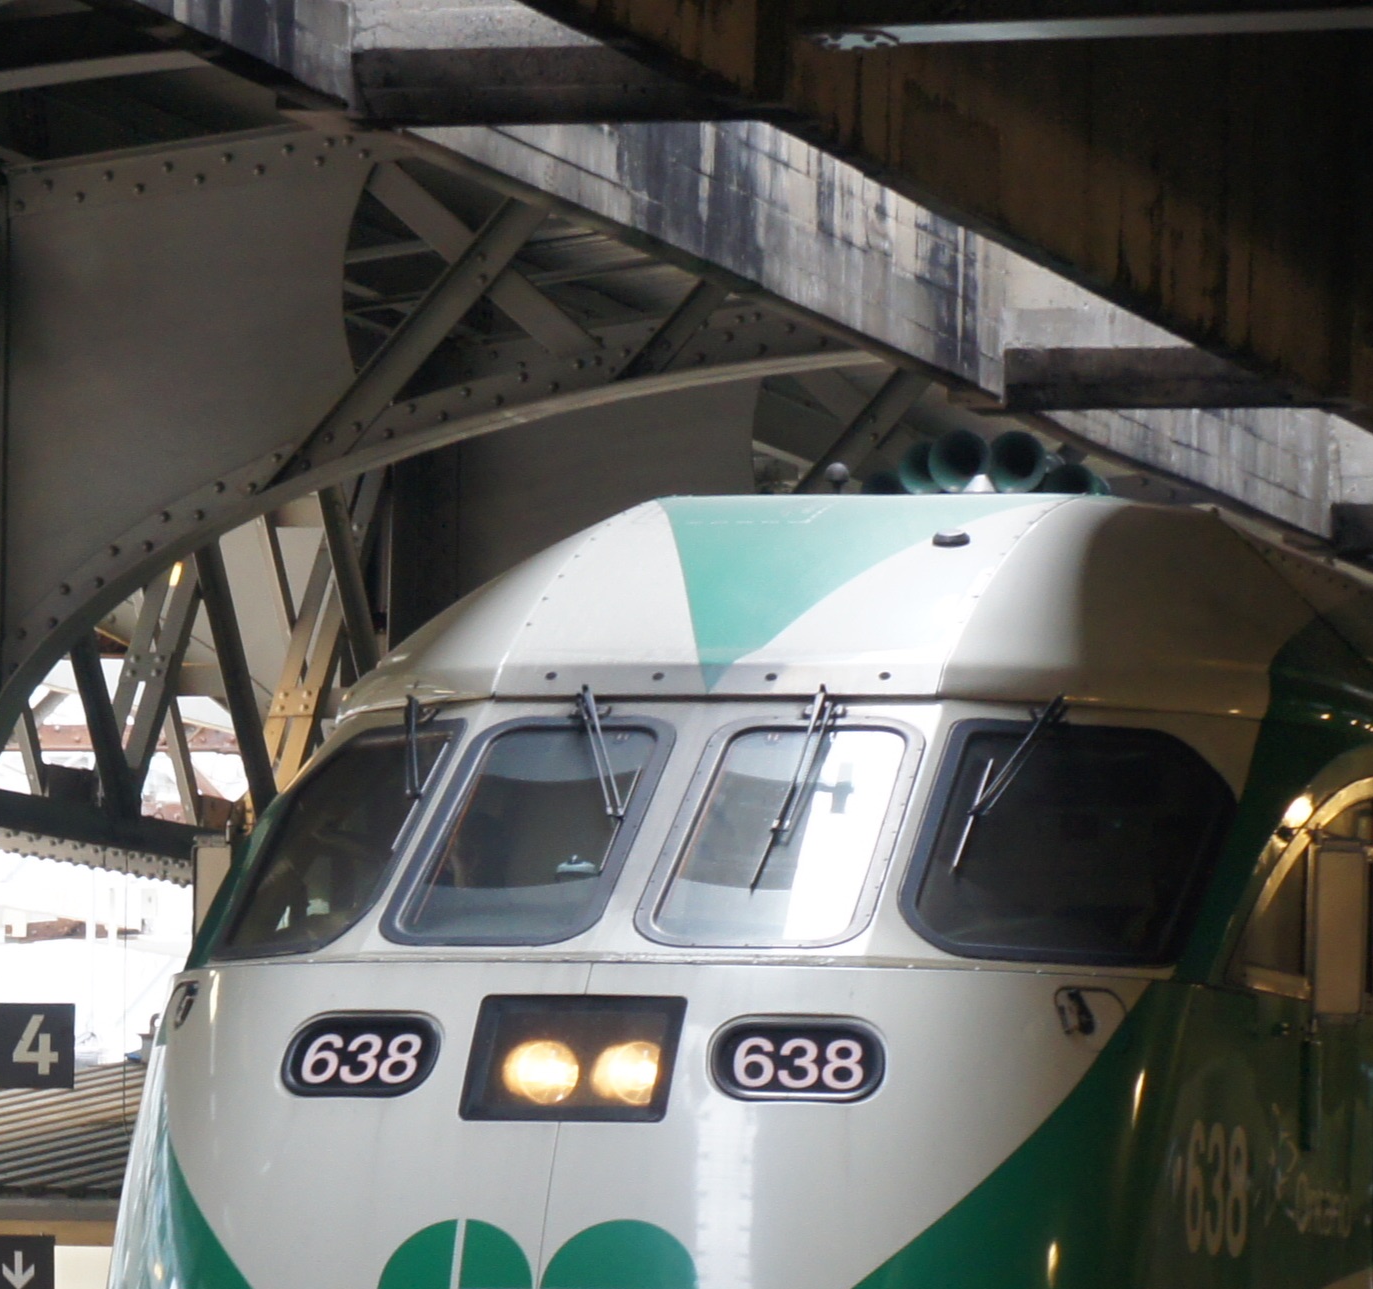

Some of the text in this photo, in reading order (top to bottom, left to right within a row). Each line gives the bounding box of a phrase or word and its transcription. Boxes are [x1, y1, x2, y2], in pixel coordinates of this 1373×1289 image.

[12, 1014, 59, 1076] 4
[301, 1033, 422, 1085] 638
[732, 1037, 864, 1090] 638
[1184, 1118, 1249, 1258] 638
